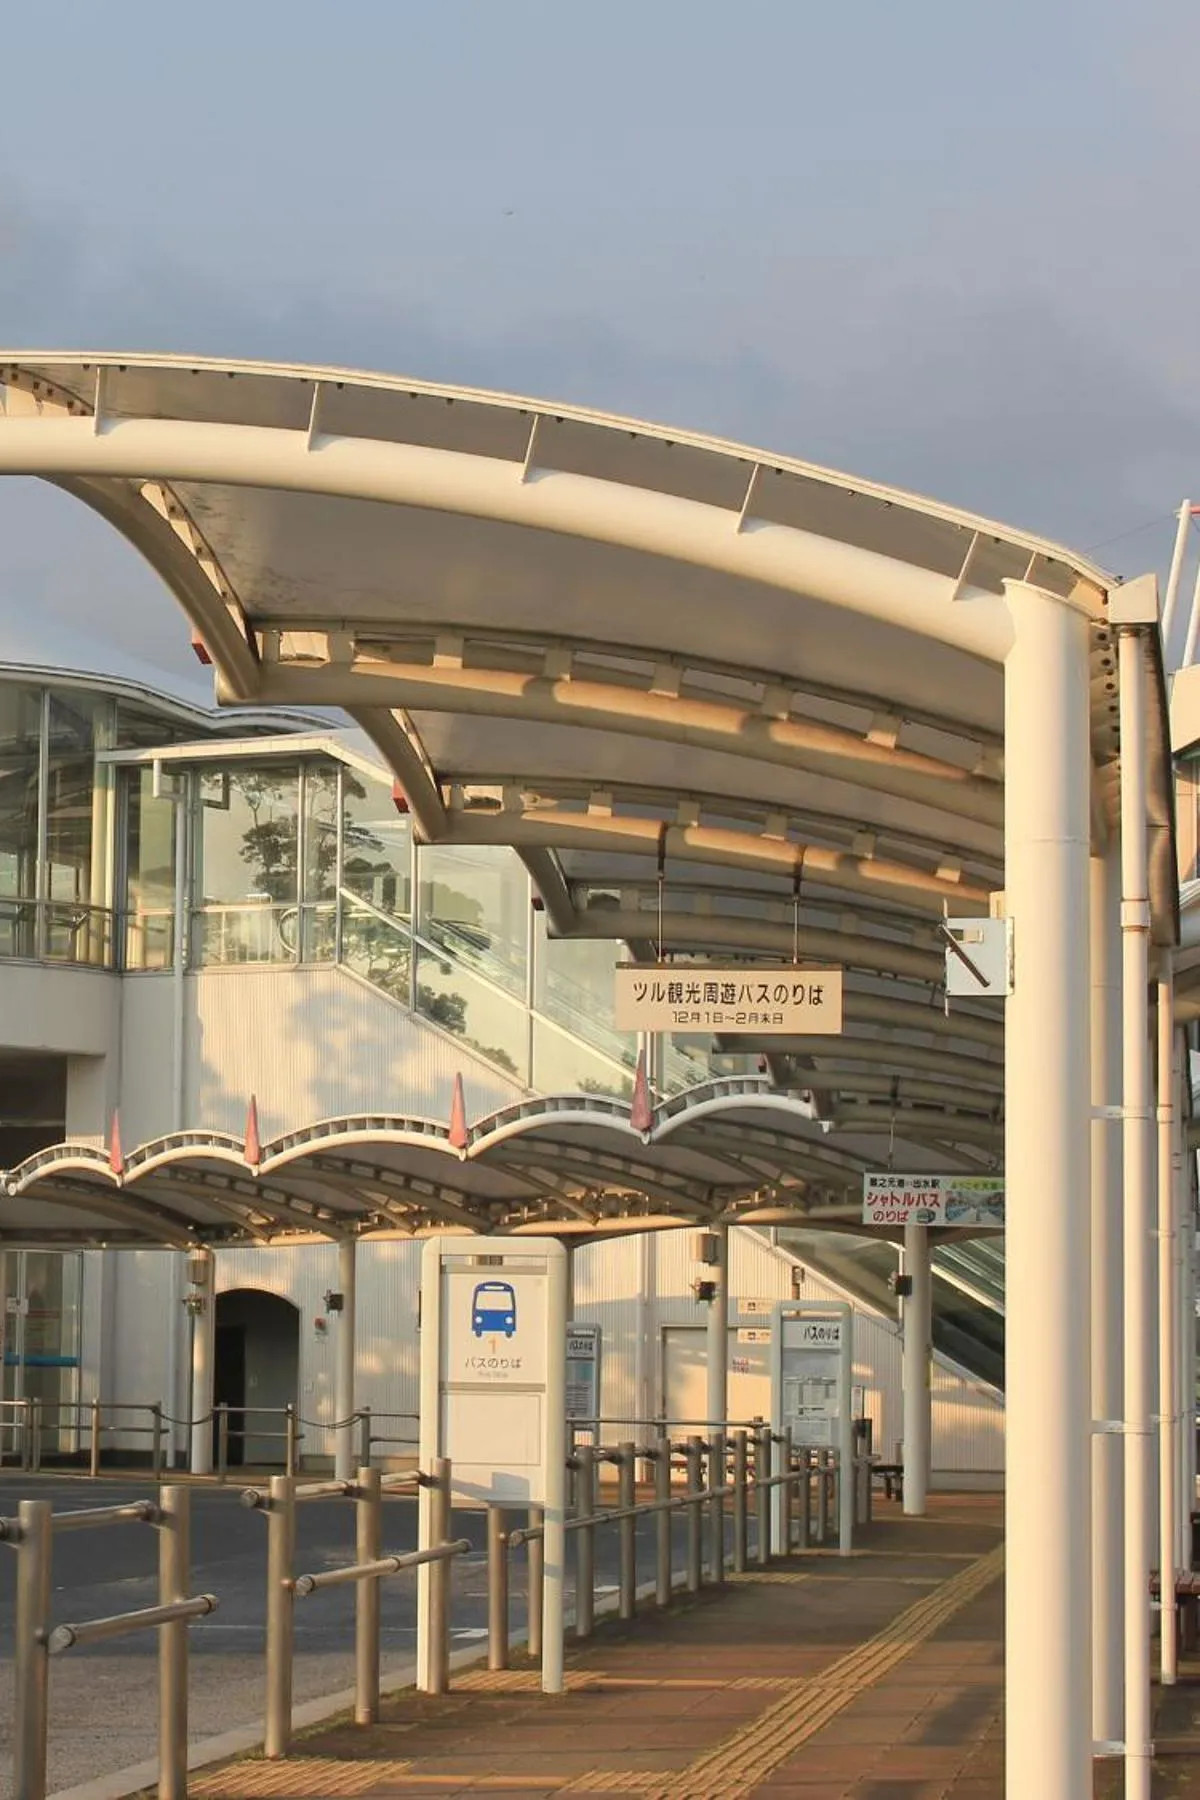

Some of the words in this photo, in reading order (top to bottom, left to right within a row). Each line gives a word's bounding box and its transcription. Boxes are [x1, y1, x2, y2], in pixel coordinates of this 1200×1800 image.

[633, 982, 824, 1005] ツル観光周遊バスのりば
[867, 1192, 941, 1208] シャトルバス
[873, 1210, 909, 1222] のりば
[465, 1357, 522, 1369] バスのりば
